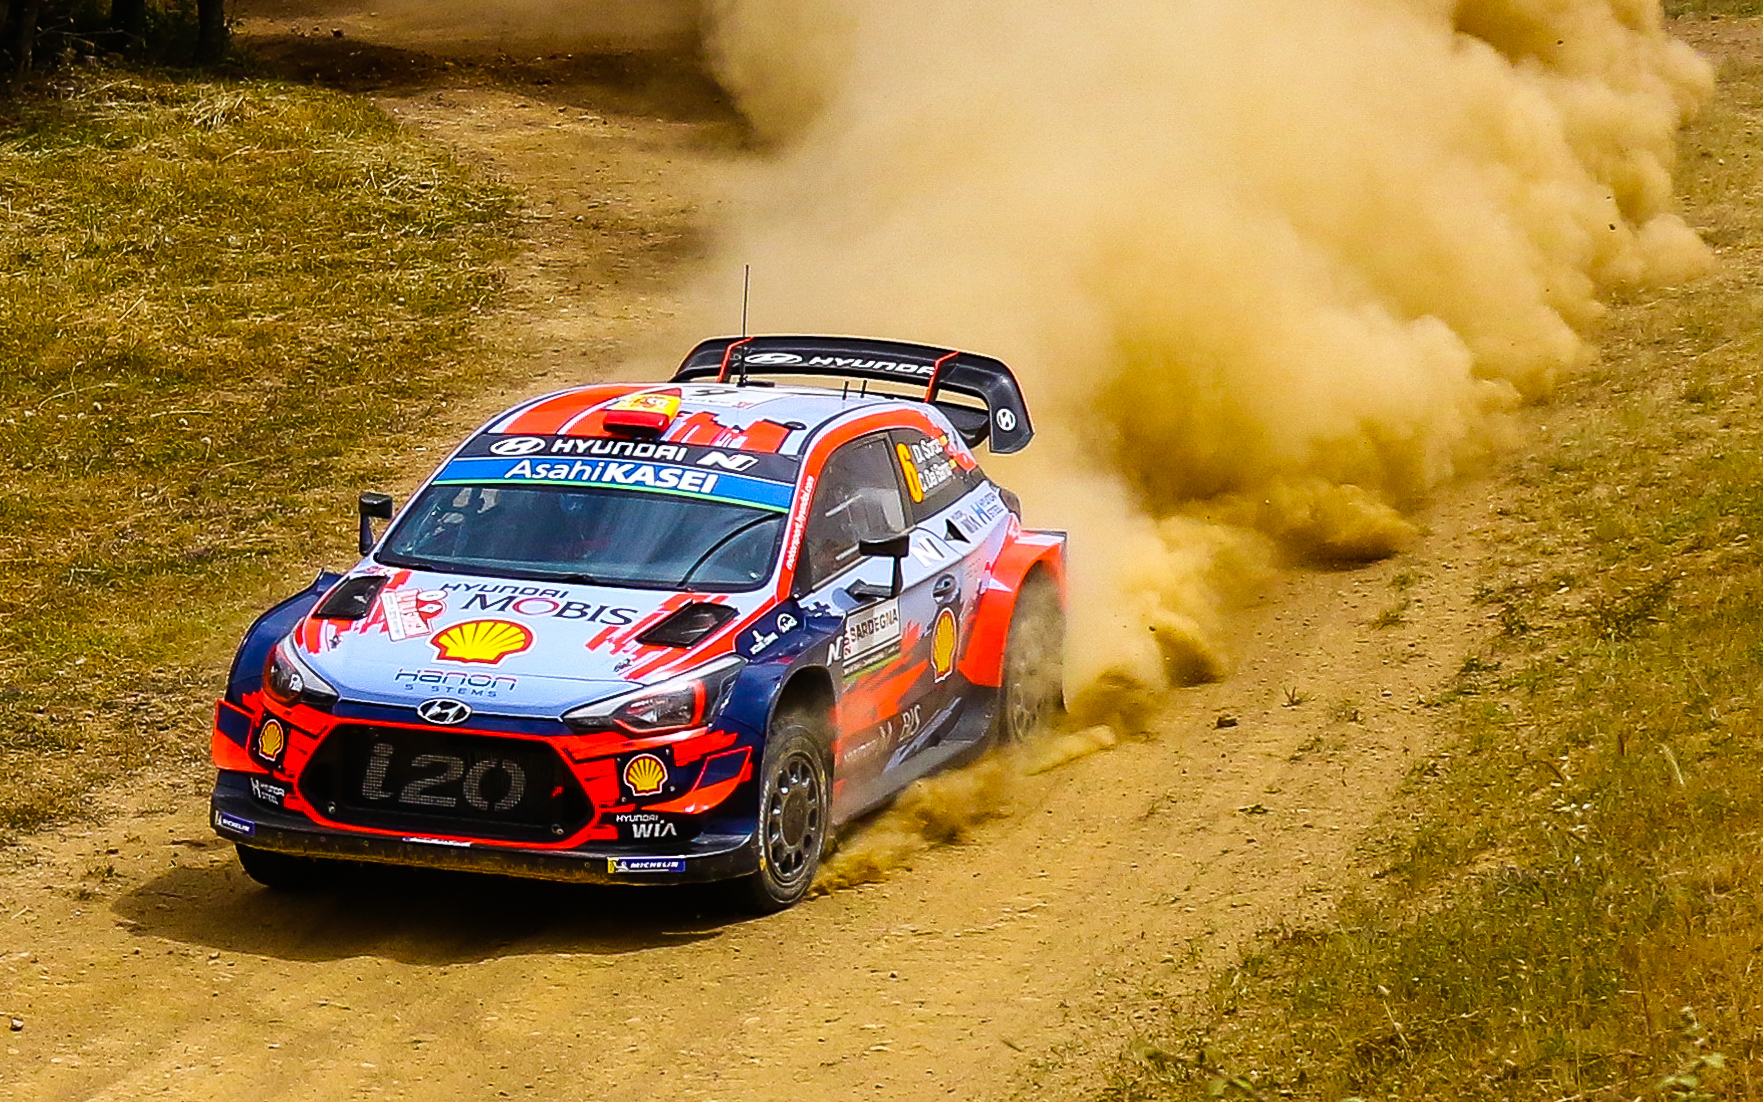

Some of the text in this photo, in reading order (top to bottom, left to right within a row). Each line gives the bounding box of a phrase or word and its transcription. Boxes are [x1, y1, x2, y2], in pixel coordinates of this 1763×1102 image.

[808, 356, 936, 377] HYUNDA
[550, 439, 689, 463] HYUNDAI
[504, 459, 720, 494] AsahiKASEI
[896, 442, 924, 503] 6
[440, 583, 569, 599] HYUNDAI
[460, 593, 639, 626] MOBIS
[850, 608, 899, 643] SARDEGNA
[615, 814, 659, 823] HYUNDAI
[629, 860, 680, 870] MICHELIN
